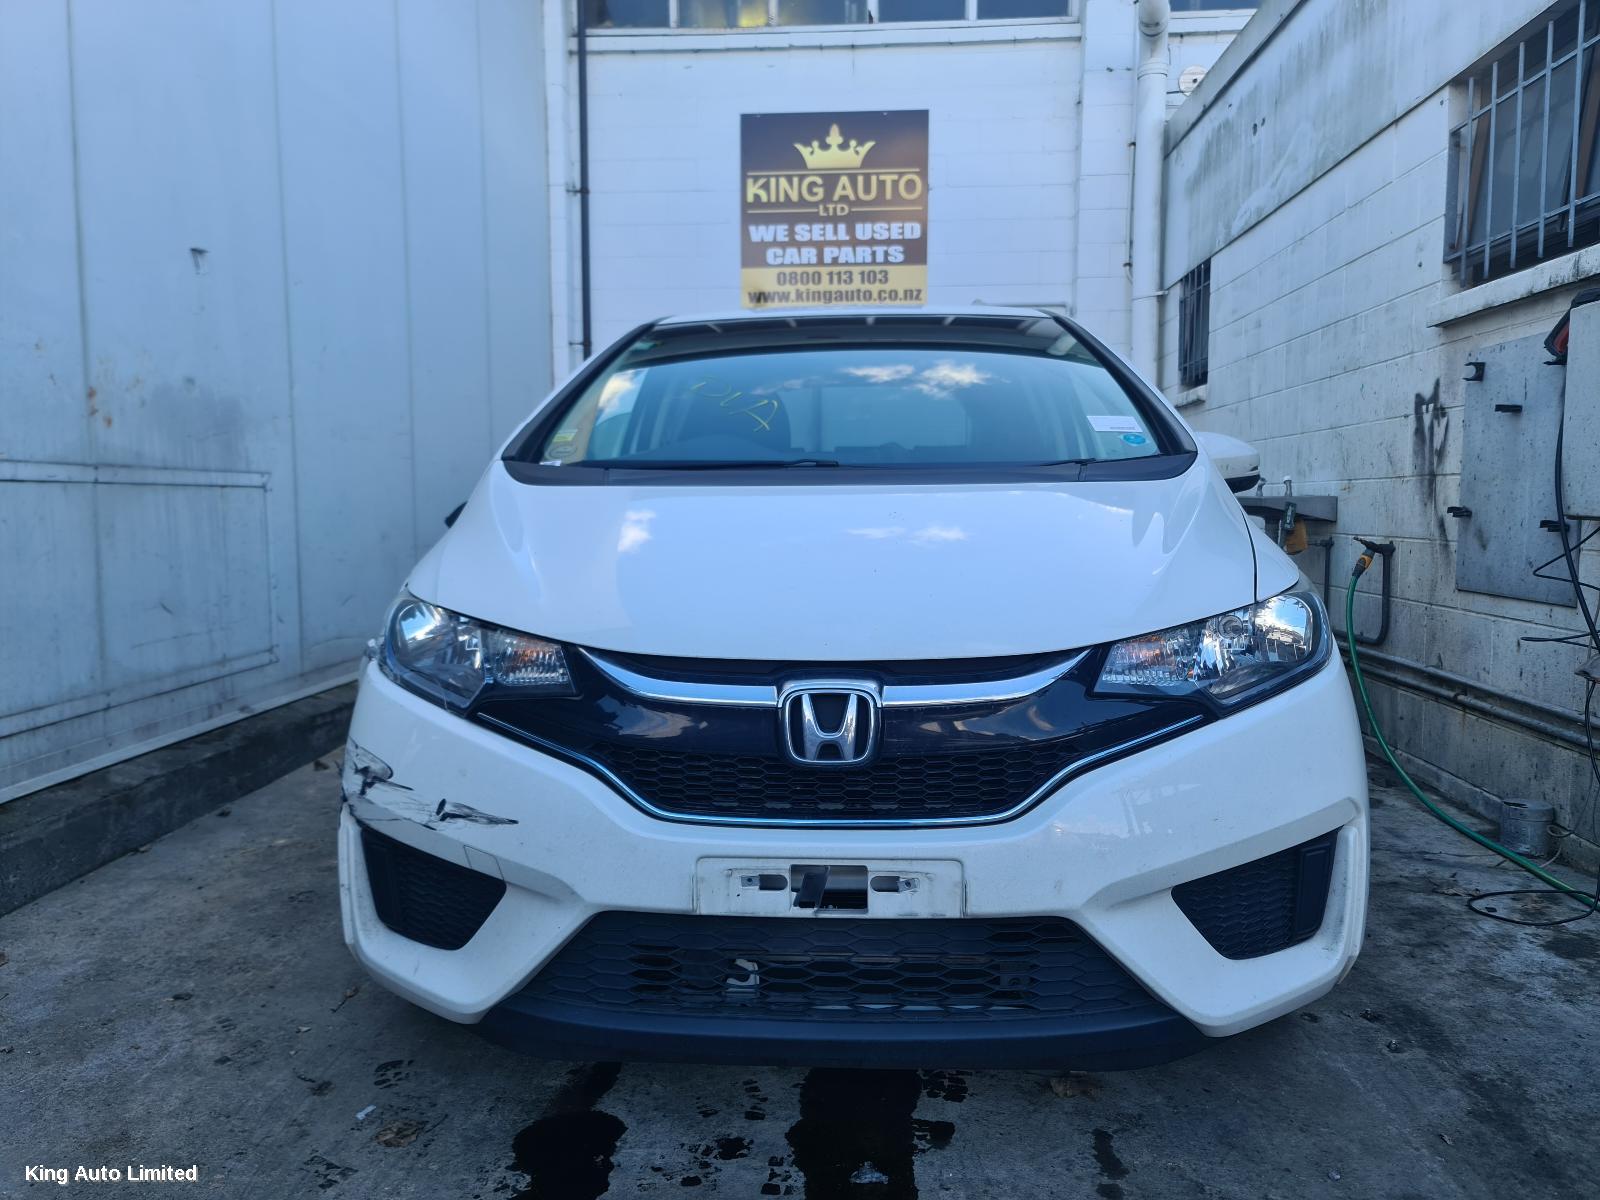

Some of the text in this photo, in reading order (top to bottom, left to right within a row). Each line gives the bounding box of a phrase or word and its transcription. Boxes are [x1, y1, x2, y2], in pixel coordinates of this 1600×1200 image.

[746, 173, 922, 203] KING AUTO
[818, 203, 849, 217] LTD
[748, 221, 921, 242] WE SELL USED
[765, 245, 905, 265] CAR PARTS
[776, 269, 889, 286] 0800 113 103
[748, 287, 922, 304] www.kingauto.co.nz
